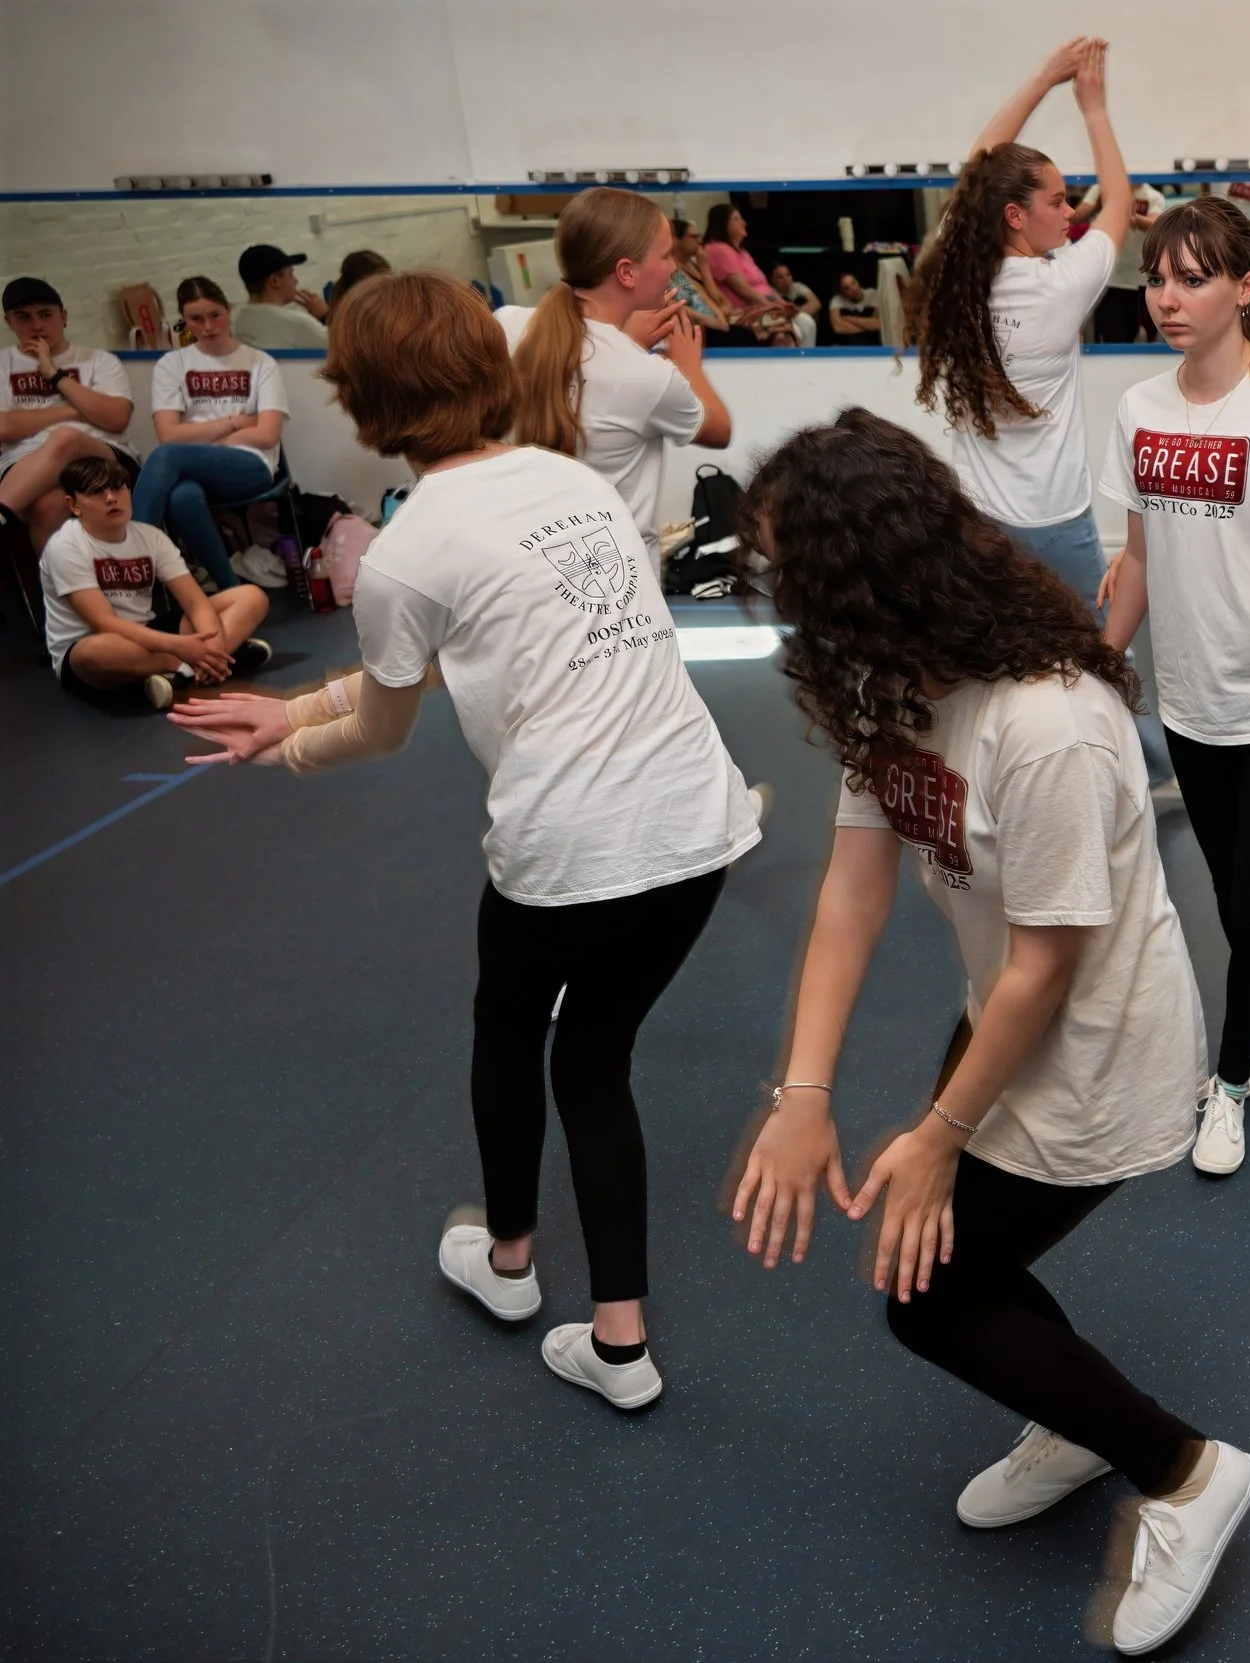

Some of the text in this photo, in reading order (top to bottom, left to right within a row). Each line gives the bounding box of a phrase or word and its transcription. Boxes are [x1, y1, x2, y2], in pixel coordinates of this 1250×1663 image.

[192, 376, 248, 391] GREASE
[1158, 437, 1222, 450] WE GO TOGETHER
[1138, 446, 1239, 486] GREASE
[1148, 481, 1165, 492] THE
[1172, 484, 1215, 497] MUSICAL
[1225, 490, 1235, 499] 59
[1140, 498, 1236, 519] SYTCo 2025
[518, 511, 613, 550] DEREHAM
[554, 555, 640, 615] THEATRE COMPANY
[621, 636, 649, 651] May
[651, 628, 674, 642] 2025
[884, 764, 959, 848] GRESE
[949, 853, 959, 866] 59
